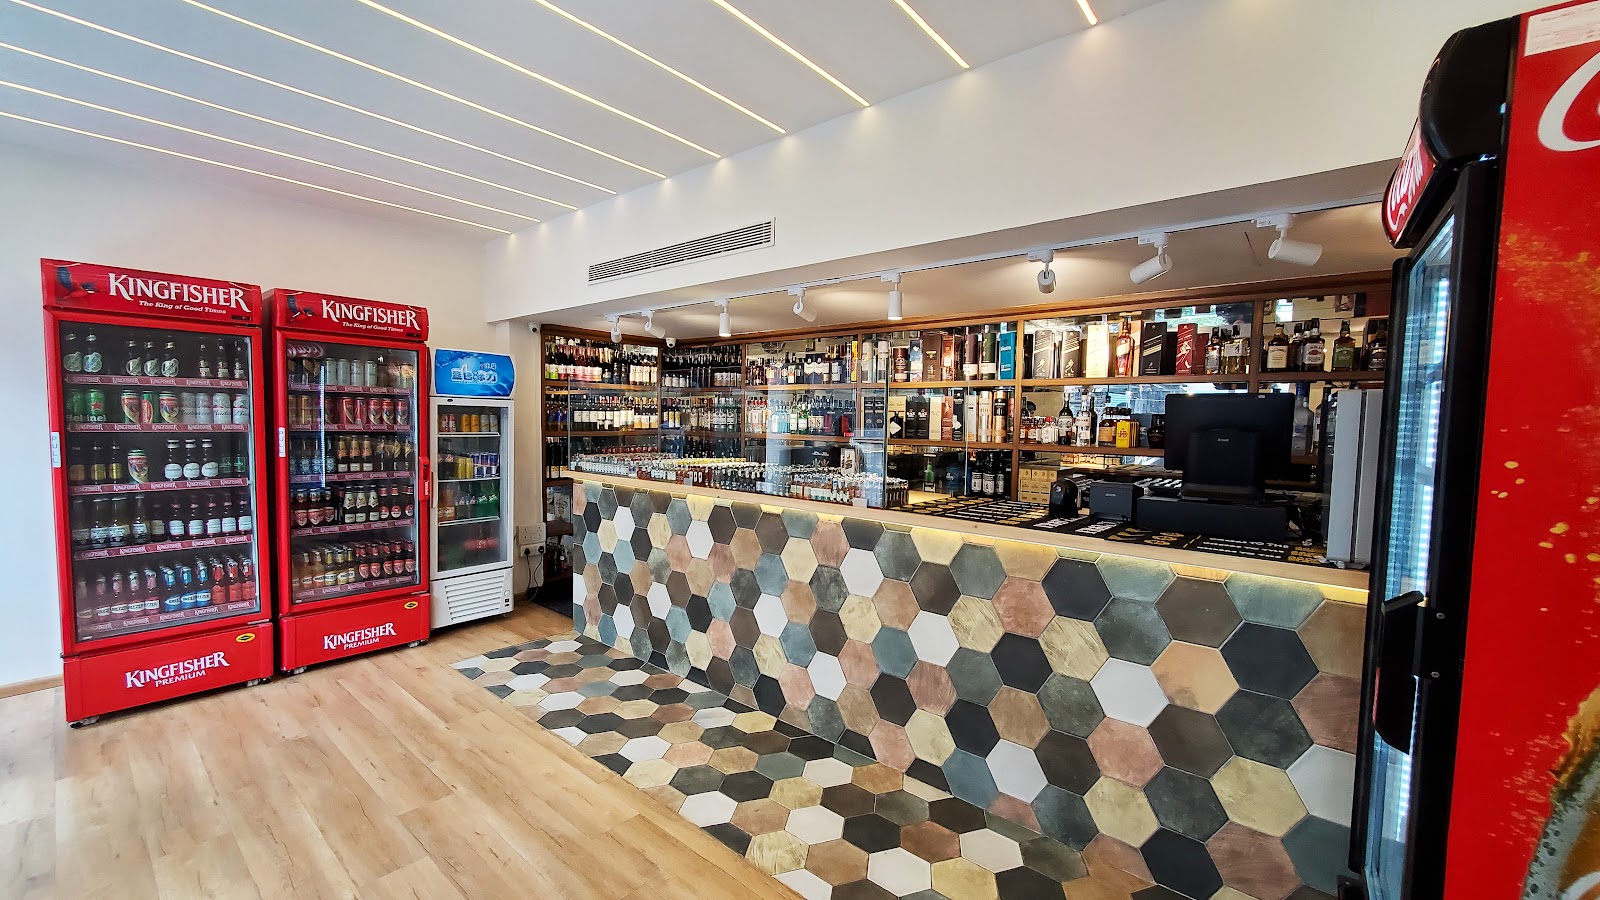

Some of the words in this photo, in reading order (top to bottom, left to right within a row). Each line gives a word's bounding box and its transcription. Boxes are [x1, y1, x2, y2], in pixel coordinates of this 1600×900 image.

[108, 272, 252, 312] KINGFISHER
[138, 300, 154, 308] The
[155, 301, 174, 310] King
[175, 302, 183, 310] of
[184, 304, 204, 312] Good
[204, 306, 226, 314] Times
[321, 299, 421, 330] KINGFISHER
[354, 322, 368, 330] King
[323, 622, 396, 650] KINGFISHER
[343, 637, 380, 650] PREMIUM
[126, 652, 230, 689] KINGFISHER
[155, 670, 206, 688] PREMIUM
